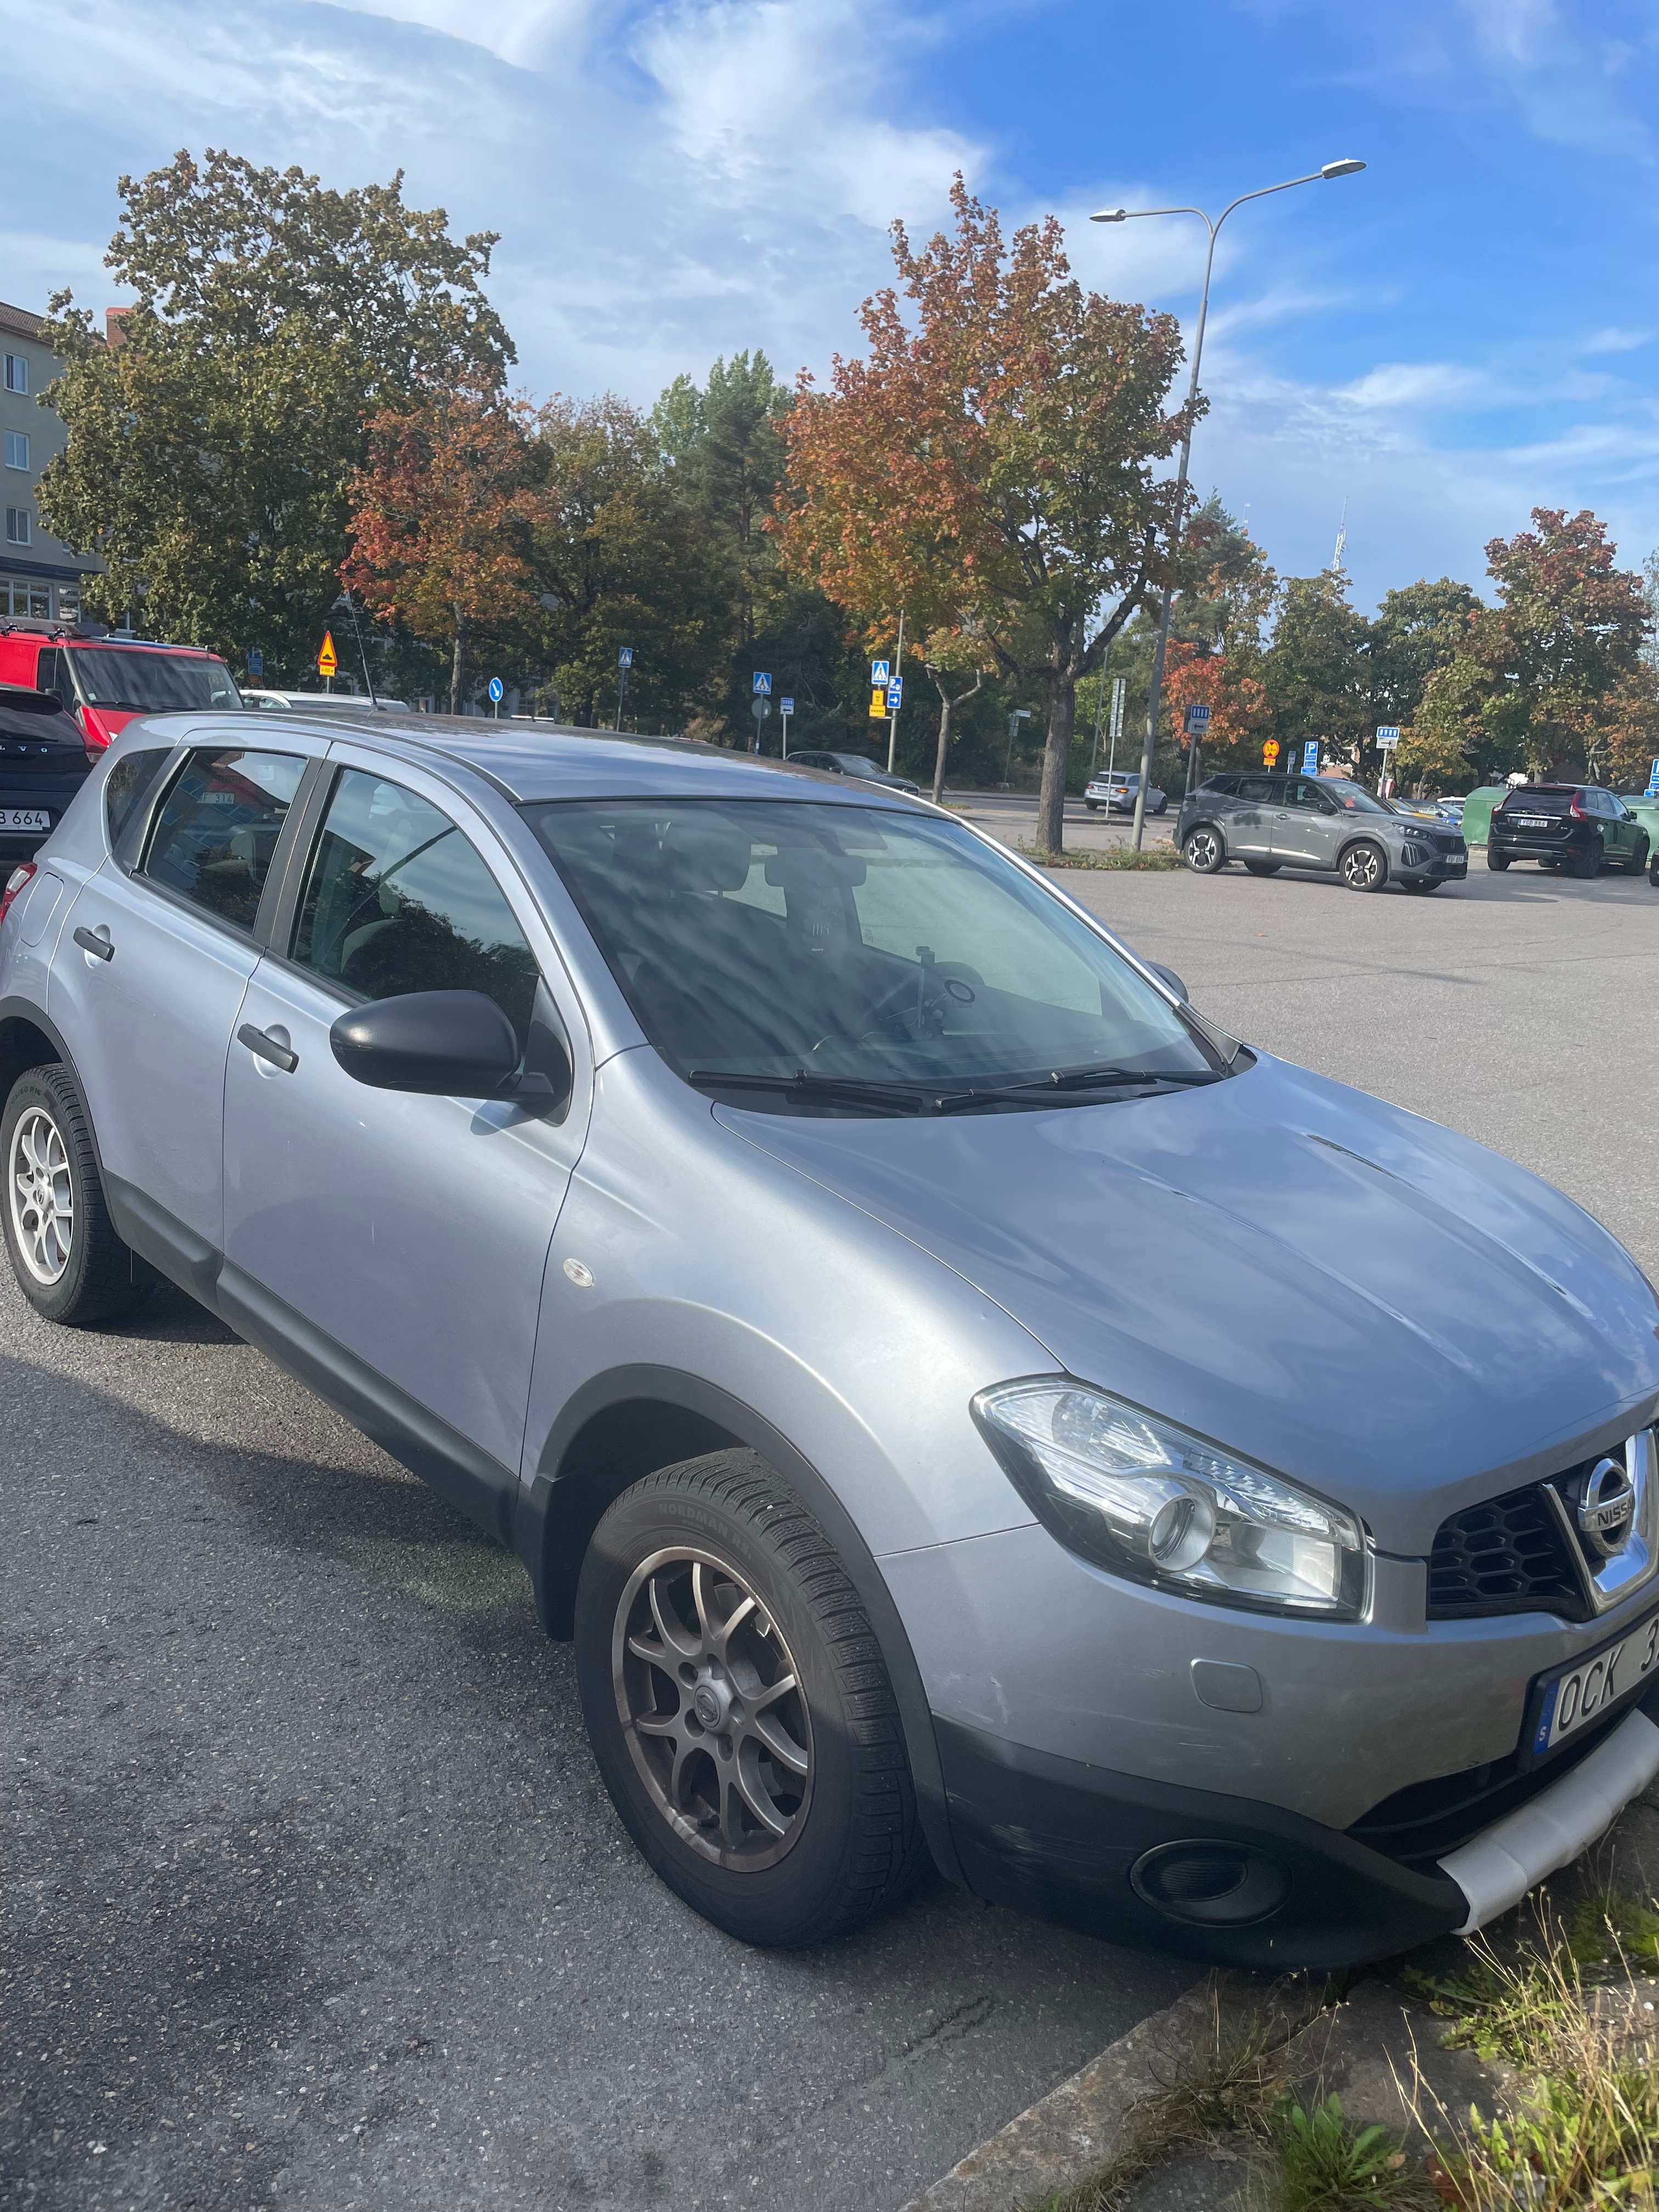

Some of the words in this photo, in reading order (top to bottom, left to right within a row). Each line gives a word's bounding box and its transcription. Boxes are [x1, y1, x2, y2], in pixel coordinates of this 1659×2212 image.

[1308, 743, 1316, 753] P
[216, 794, 231, 802] 314
[13, 811, 43, 825] 664
[30, 1086, 42, 1096] R16
[1597, 1498, 1634, 1526] NISSA
[658, 1504, 729, 1537] NORDMAN
[1557, 1644, 1626, 1731] OCK
[1640, 1618, 1659, 1672] 3
[1539, 1726, 1547, 1742] S
